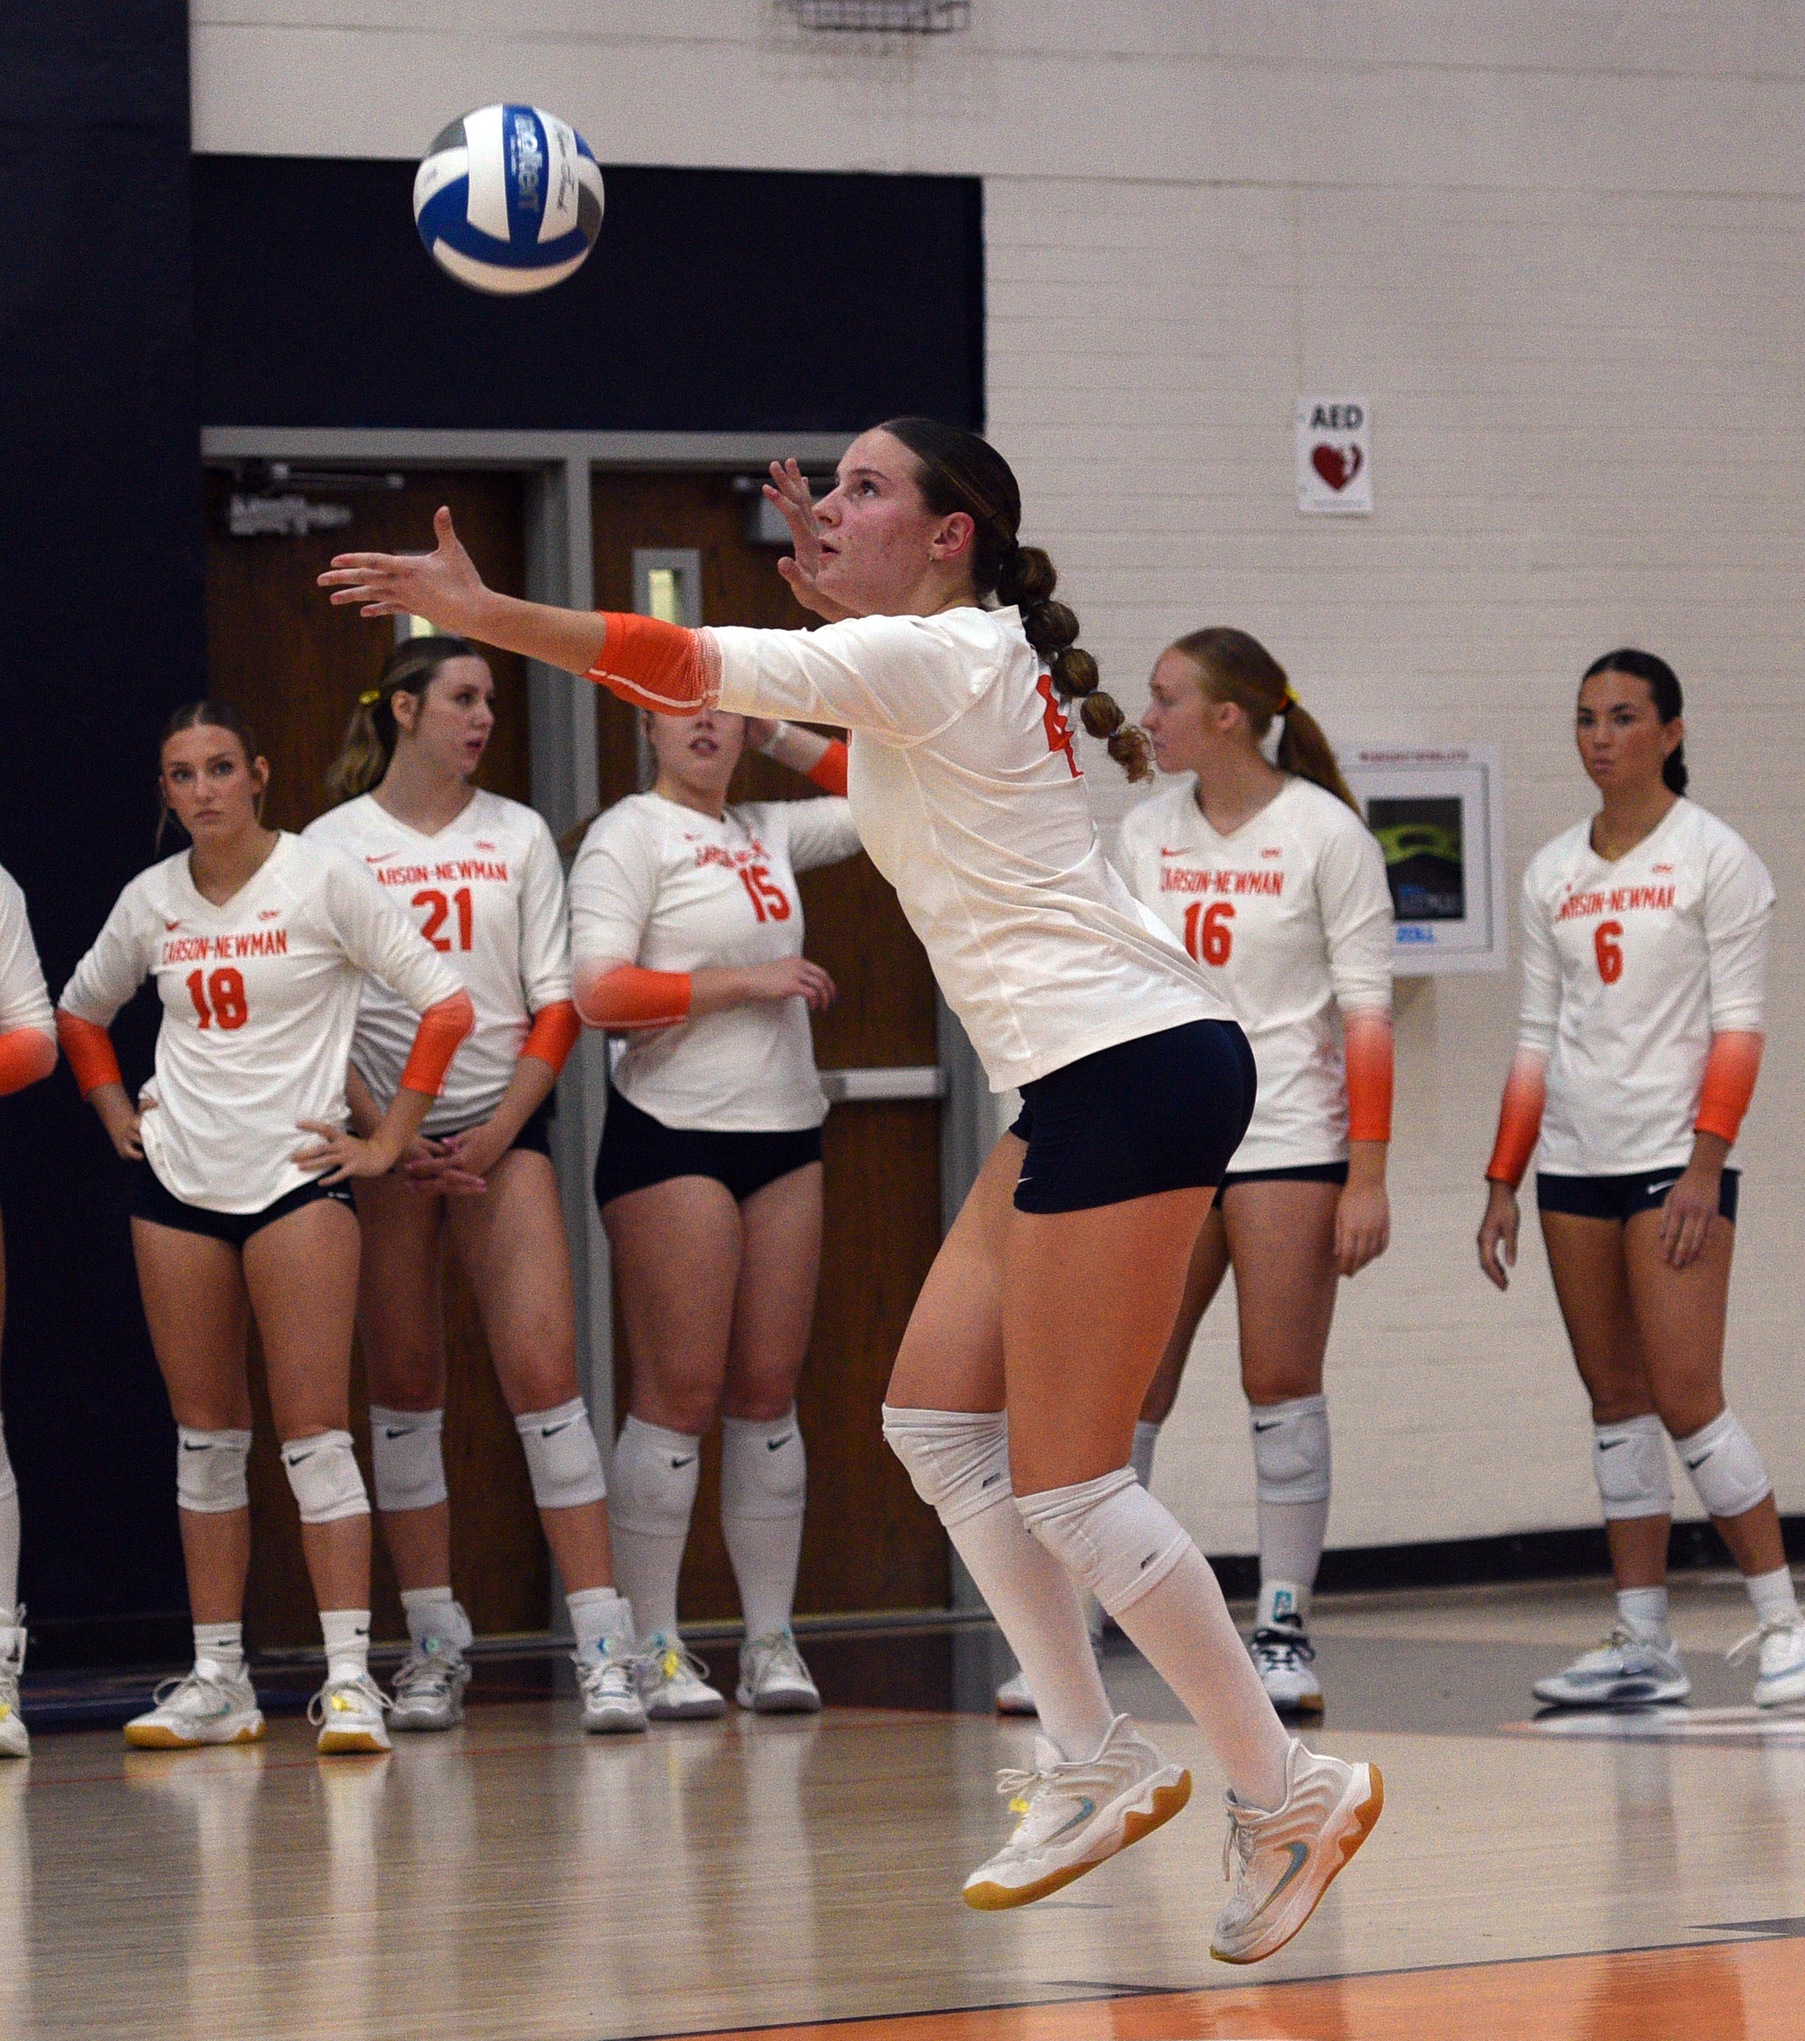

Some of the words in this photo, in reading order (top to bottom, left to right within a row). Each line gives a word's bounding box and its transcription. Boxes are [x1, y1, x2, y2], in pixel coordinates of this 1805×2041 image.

[1310, 404, 1364, 430] AED
[377, 859, 509, 887] ARSON-NEWMAN
[739, 865, 792, 924] 15
[411, 886, 473, 952] 21
[1184, 900, 1237, 968] 16
[1594, 920, 1625, 985] 6
[185, 966, 247, 1031] 18
